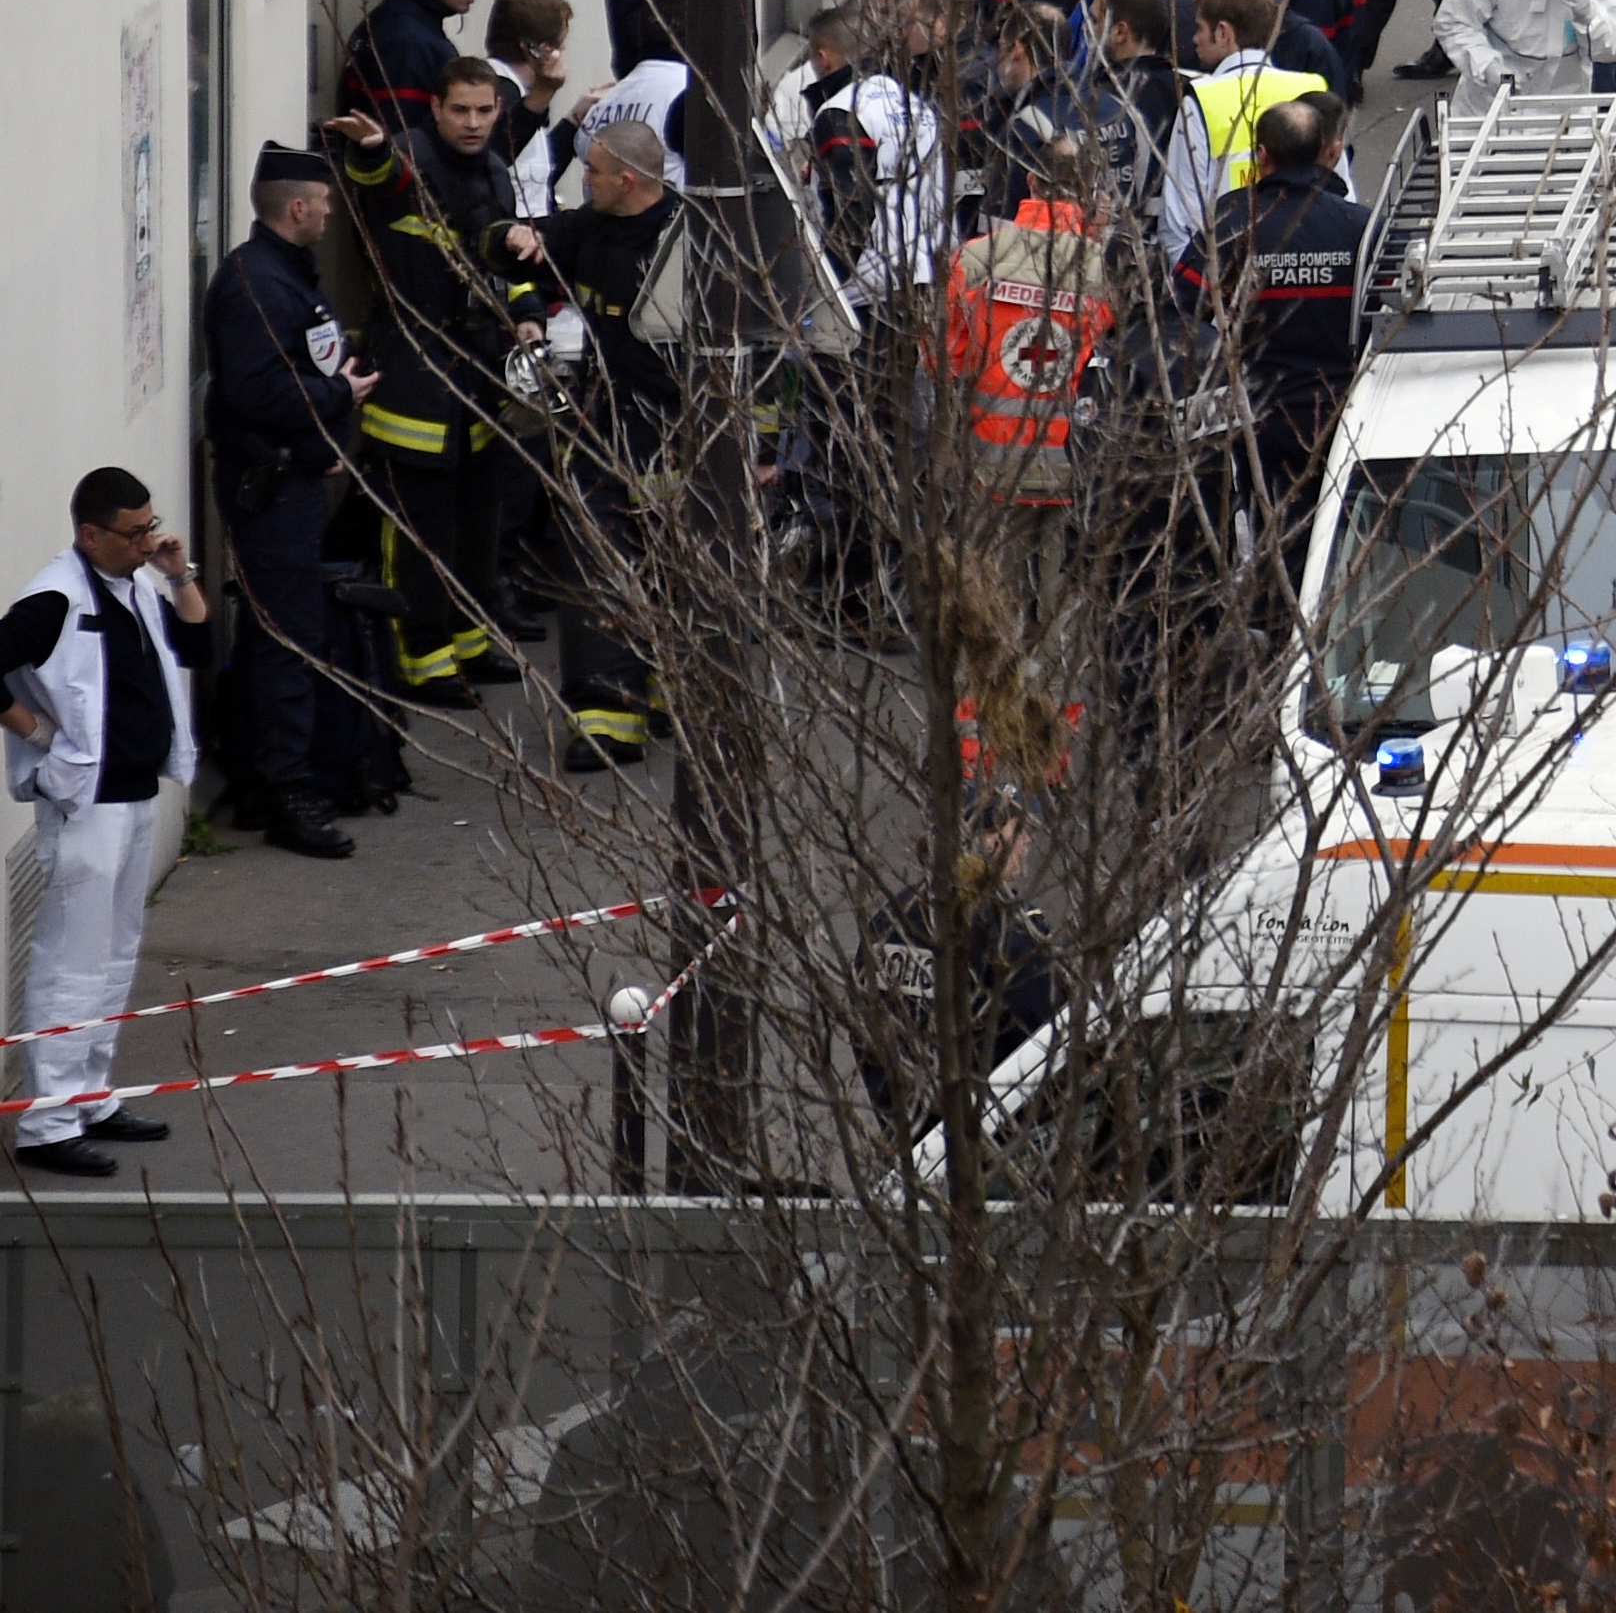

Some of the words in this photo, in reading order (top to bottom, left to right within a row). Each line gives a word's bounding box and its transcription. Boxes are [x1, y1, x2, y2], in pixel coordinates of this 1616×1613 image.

[583, 102, 653, 132] SAMU
[1253, 252, 1298, 268] SAPEURS
[1300, 251, 1351, 266] POMPIERS
[1271, 266, 1333, 285] PARIS
[1256, 910, 1350, 933] Fonaion
[1277, 935, 1324, 944] PGEOT
